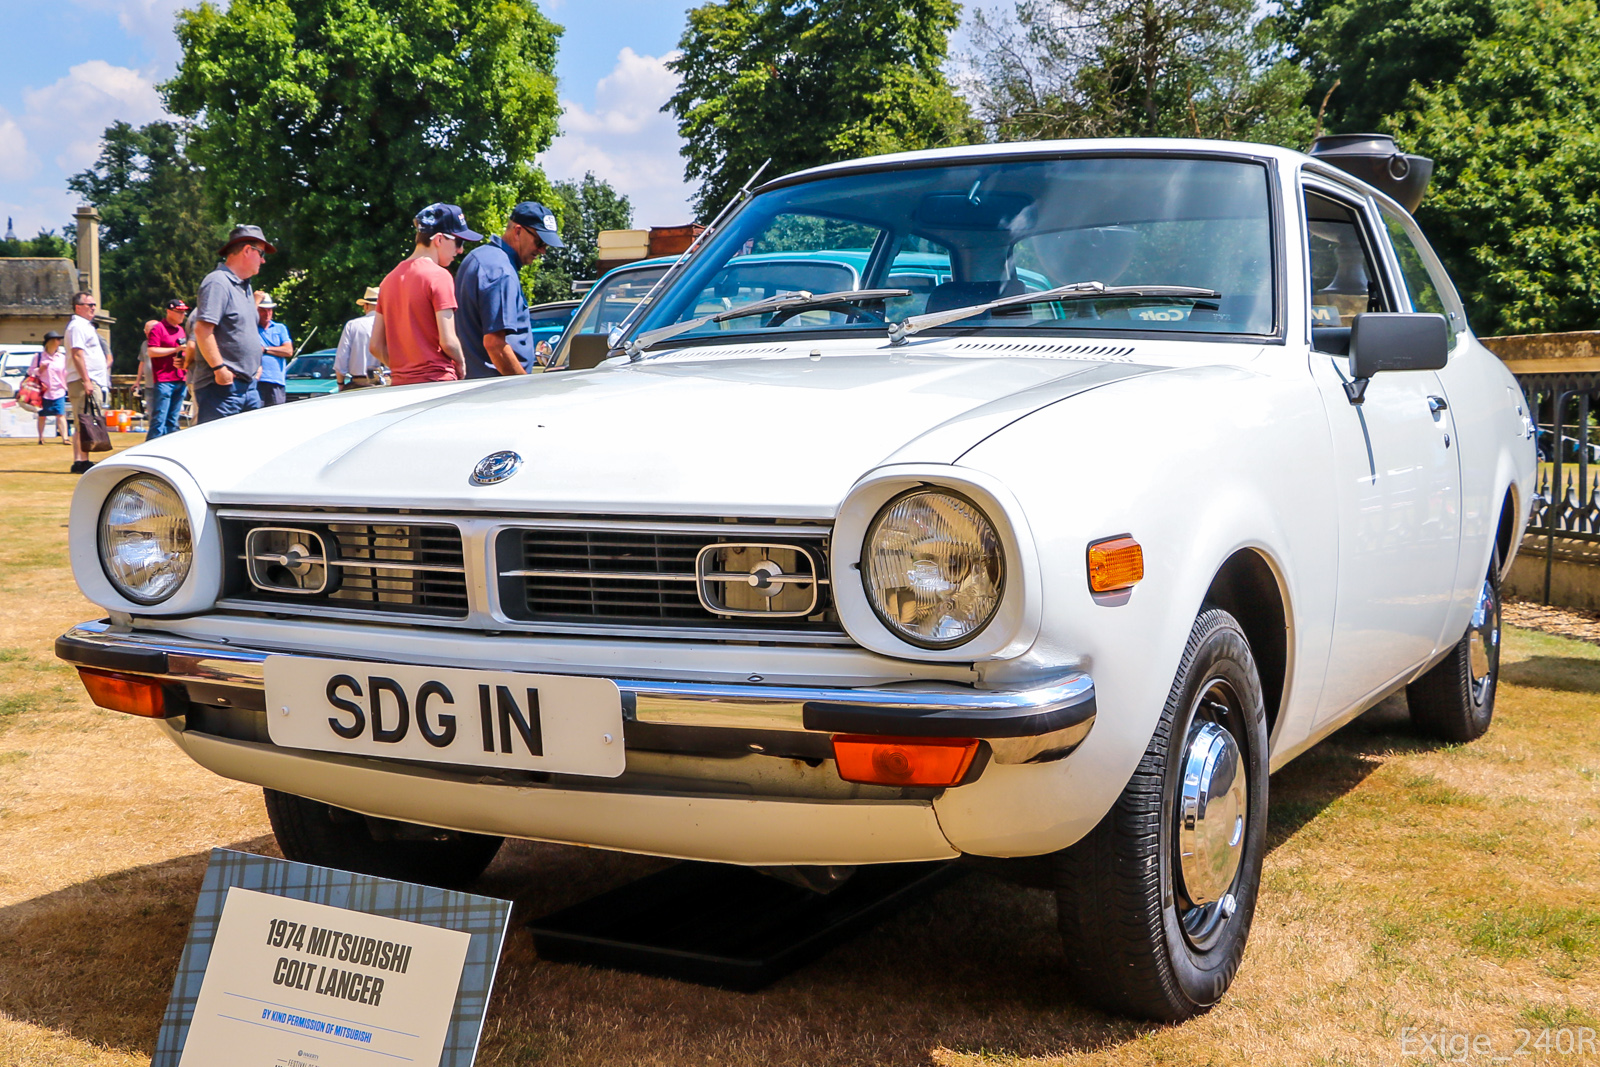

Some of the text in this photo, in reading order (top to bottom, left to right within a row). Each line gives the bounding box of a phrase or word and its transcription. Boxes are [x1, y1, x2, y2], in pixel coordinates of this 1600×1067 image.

[325, 674, 544, 757] SDG IN
[266, 918, 413, 974] 1974 MITSUBISHI
[272, 957, 385, 1006] COLT LANCER
[261, 1008, 373, 1044] BY KIND PERMISSION OF MITSUBISHI
